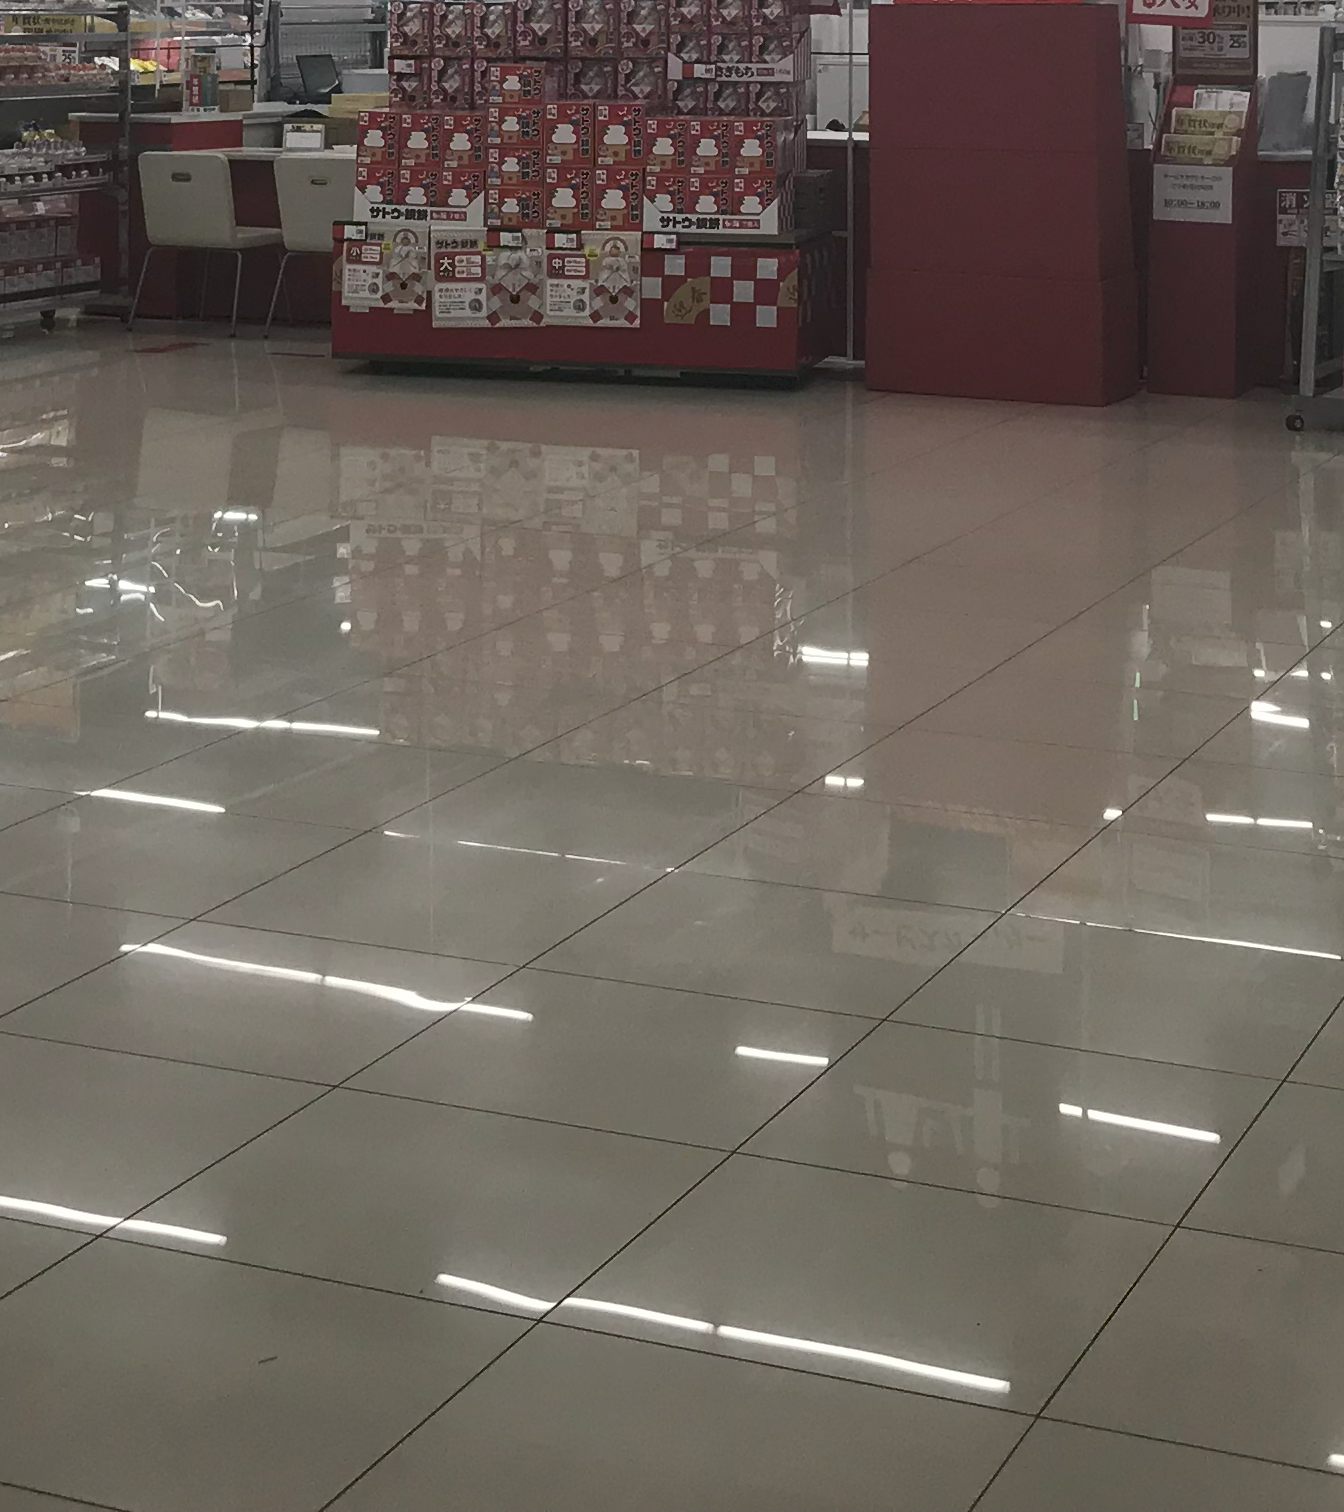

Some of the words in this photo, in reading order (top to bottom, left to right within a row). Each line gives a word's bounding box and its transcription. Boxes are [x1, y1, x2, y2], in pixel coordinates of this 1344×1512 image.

[1197, 31, 1216, 45] 30
[350, 246, 361, 256] 小
[439, 256, 453, 272] 大
[552, 258, 563, 270] 中
[672, 286, 707, 320] 迎春
